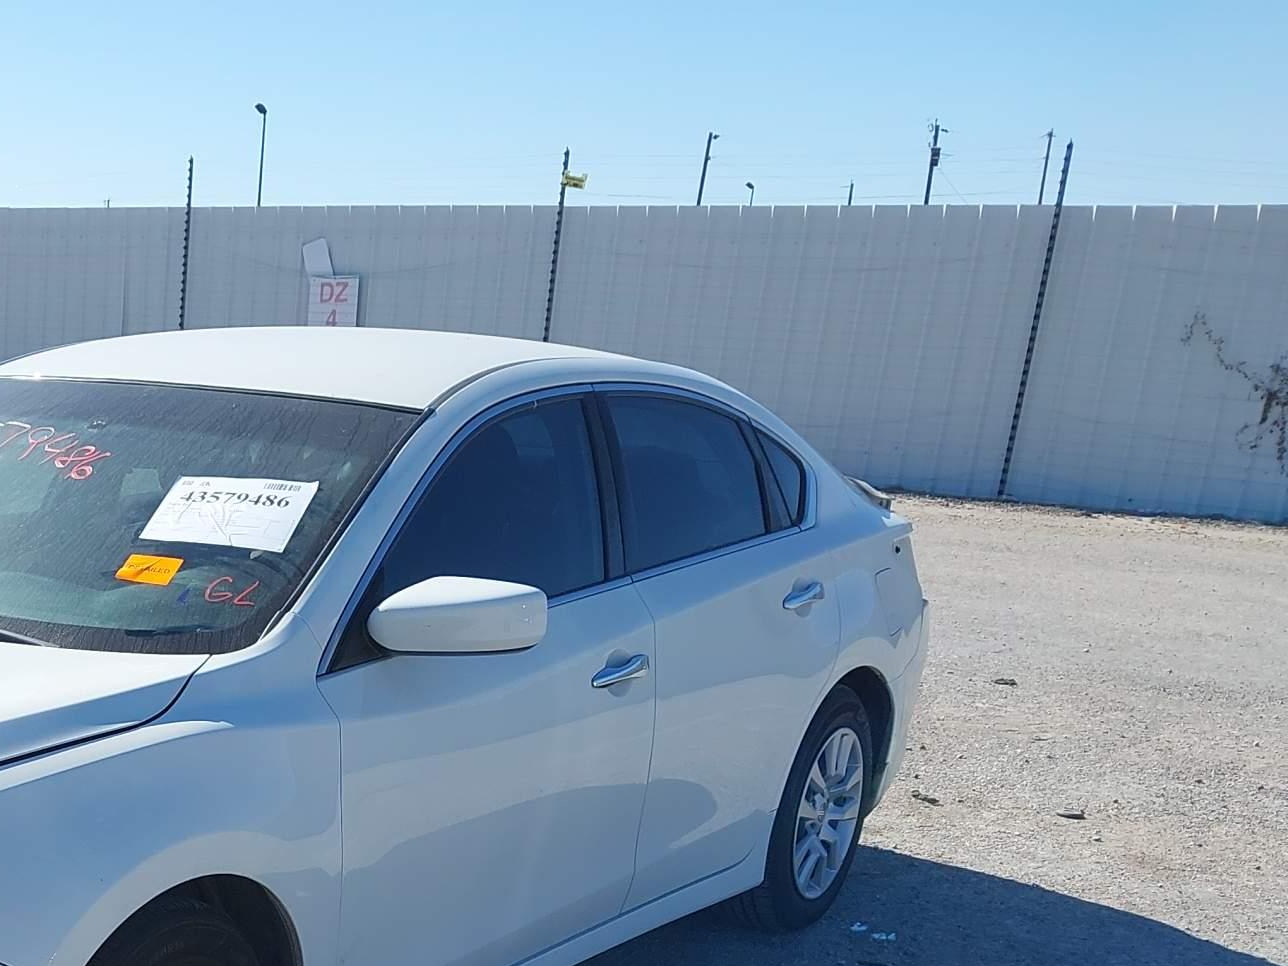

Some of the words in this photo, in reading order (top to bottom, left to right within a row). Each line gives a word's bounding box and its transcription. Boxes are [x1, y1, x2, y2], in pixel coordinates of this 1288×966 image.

[319, 282, 349, 304] DZ
[327, 309, 337, 326] 4
[179, 490, 291, 509] 43579486
